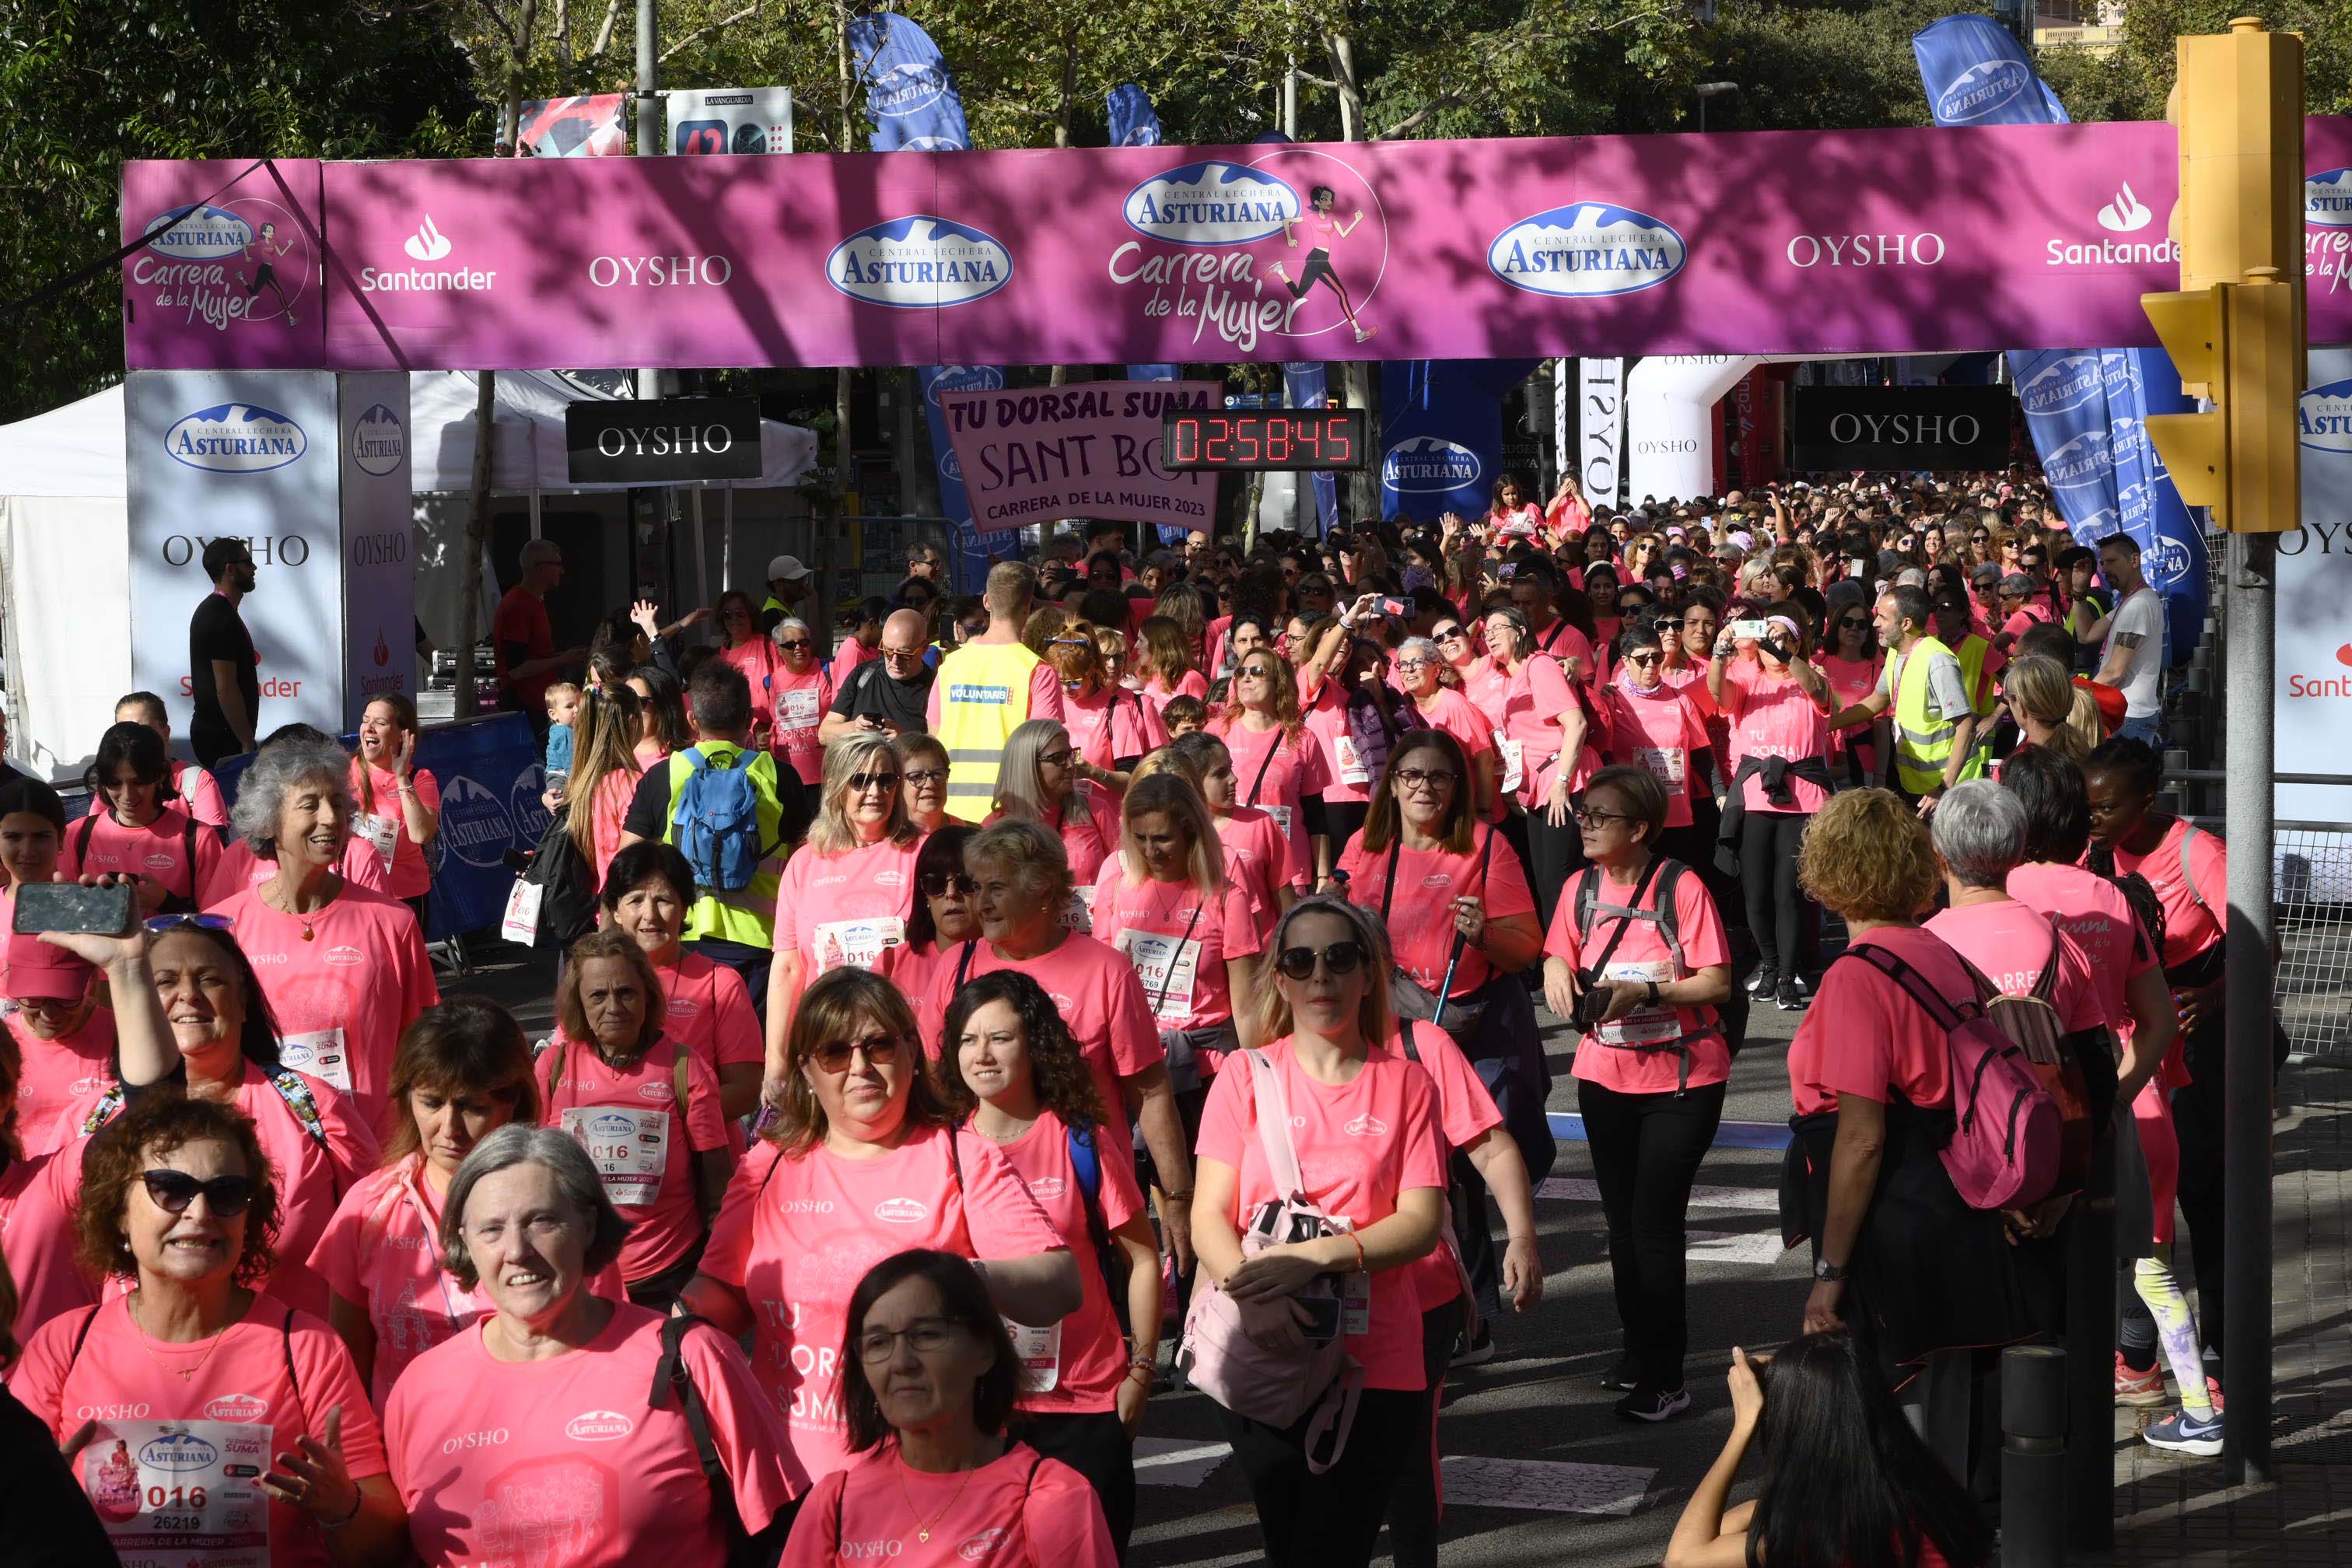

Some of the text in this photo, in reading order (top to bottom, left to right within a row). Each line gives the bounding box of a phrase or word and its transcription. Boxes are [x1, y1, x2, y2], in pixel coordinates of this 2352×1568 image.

[1164, 188, 1281, 200] CENTRAL LECHERA
[1137, 193, 1286, 225] ASTURIANA
[152, 224, 245, 246] ASTURIANA
[1535, 234, 1664, 246] CENTRAL LECHERA
[869, 247, 992, 257] CENTRAL LECHERA
[1503, 239, 1671, 274] ASTURIANA
[1787, 233, 1945, 268] OYSHO
[2047, 238, 2181, 265] Santande
[133, 257, 225, 285] Carrera
[589, 255, 732, 287] OYSHO
[841, 250, 999, 284] ASTURIANA
[1108, 241, 1254, 285] Carrera
[2319, 255, 2333, 275] la
[362, 267, 495, 291] Santander
[156, 284, 189, 307] de la
[186, 283, 260, 331] Mujer
[1144, 285, 1197, 317] de la
[1192, 279, 1309, 352] Mujer
[949, 399, 987, 432] TU
[996, 390, 1115, 429] DORSAL
[247, 426, 292, 435] LECHERA
[597, 424, 733, 457] OYSHO
[1177, 418, 1349, 461] 02:58:45
[1829, 412, 1979, 446] OYSHO
[176, 429, 297, 456] ASTURIANA
[357, 439, 402, 459] ASTURIANA
[1638, 439, 1697, 455] OYSHO
[980, 435, 1097, 492] SANT
[1385, 459, 1473, 481] ASTURIANA
[987, 492, 1206, 520] CARRERA DE LA MUJER 2023
[354, 532, 406, 567] OYSHO
[361, 673, 404, 696] Santander
[950, 689, 1006, 700] VOLUNTARIS
[1749, 730, 1765, 741] TU
[1751, 746, 1801, 758] DORSAL
[446, 813, 512, 849] ASTURIANA
[327, 954, 361, 963] ASTURIANA
[847, 950, 875, 964] 016
[1135, 963, 1164, 979] 016
[317, 1042, 338, 1051] SUMA
[592, 1145, 628, 1159] 016
[780, 1199, 834, 1214] OYSHO
[762, 1300, 801, 1330] TU
[77, 1403, 150, 1420] OYSHO
[571, 1423, 628, 1436] ASTURIANA
[224, 1444, 260, 1454] SUMA
[442, 1428, 509, 1455] OYSHO
[145, 1448, 212, 1463] ASTURIANA
[147, 1486, 207, 1509] 016
[152, 1516, 201, 1530] 26219
[114, 1537, 156, 1547] ARRERA
[158, 1537, 173, 1546] DE
[174, 1537, 188, 1546] LA
[190, 1537, 225, 1546] MUJER
[840, 1539, 903, 1559] OYSHO
